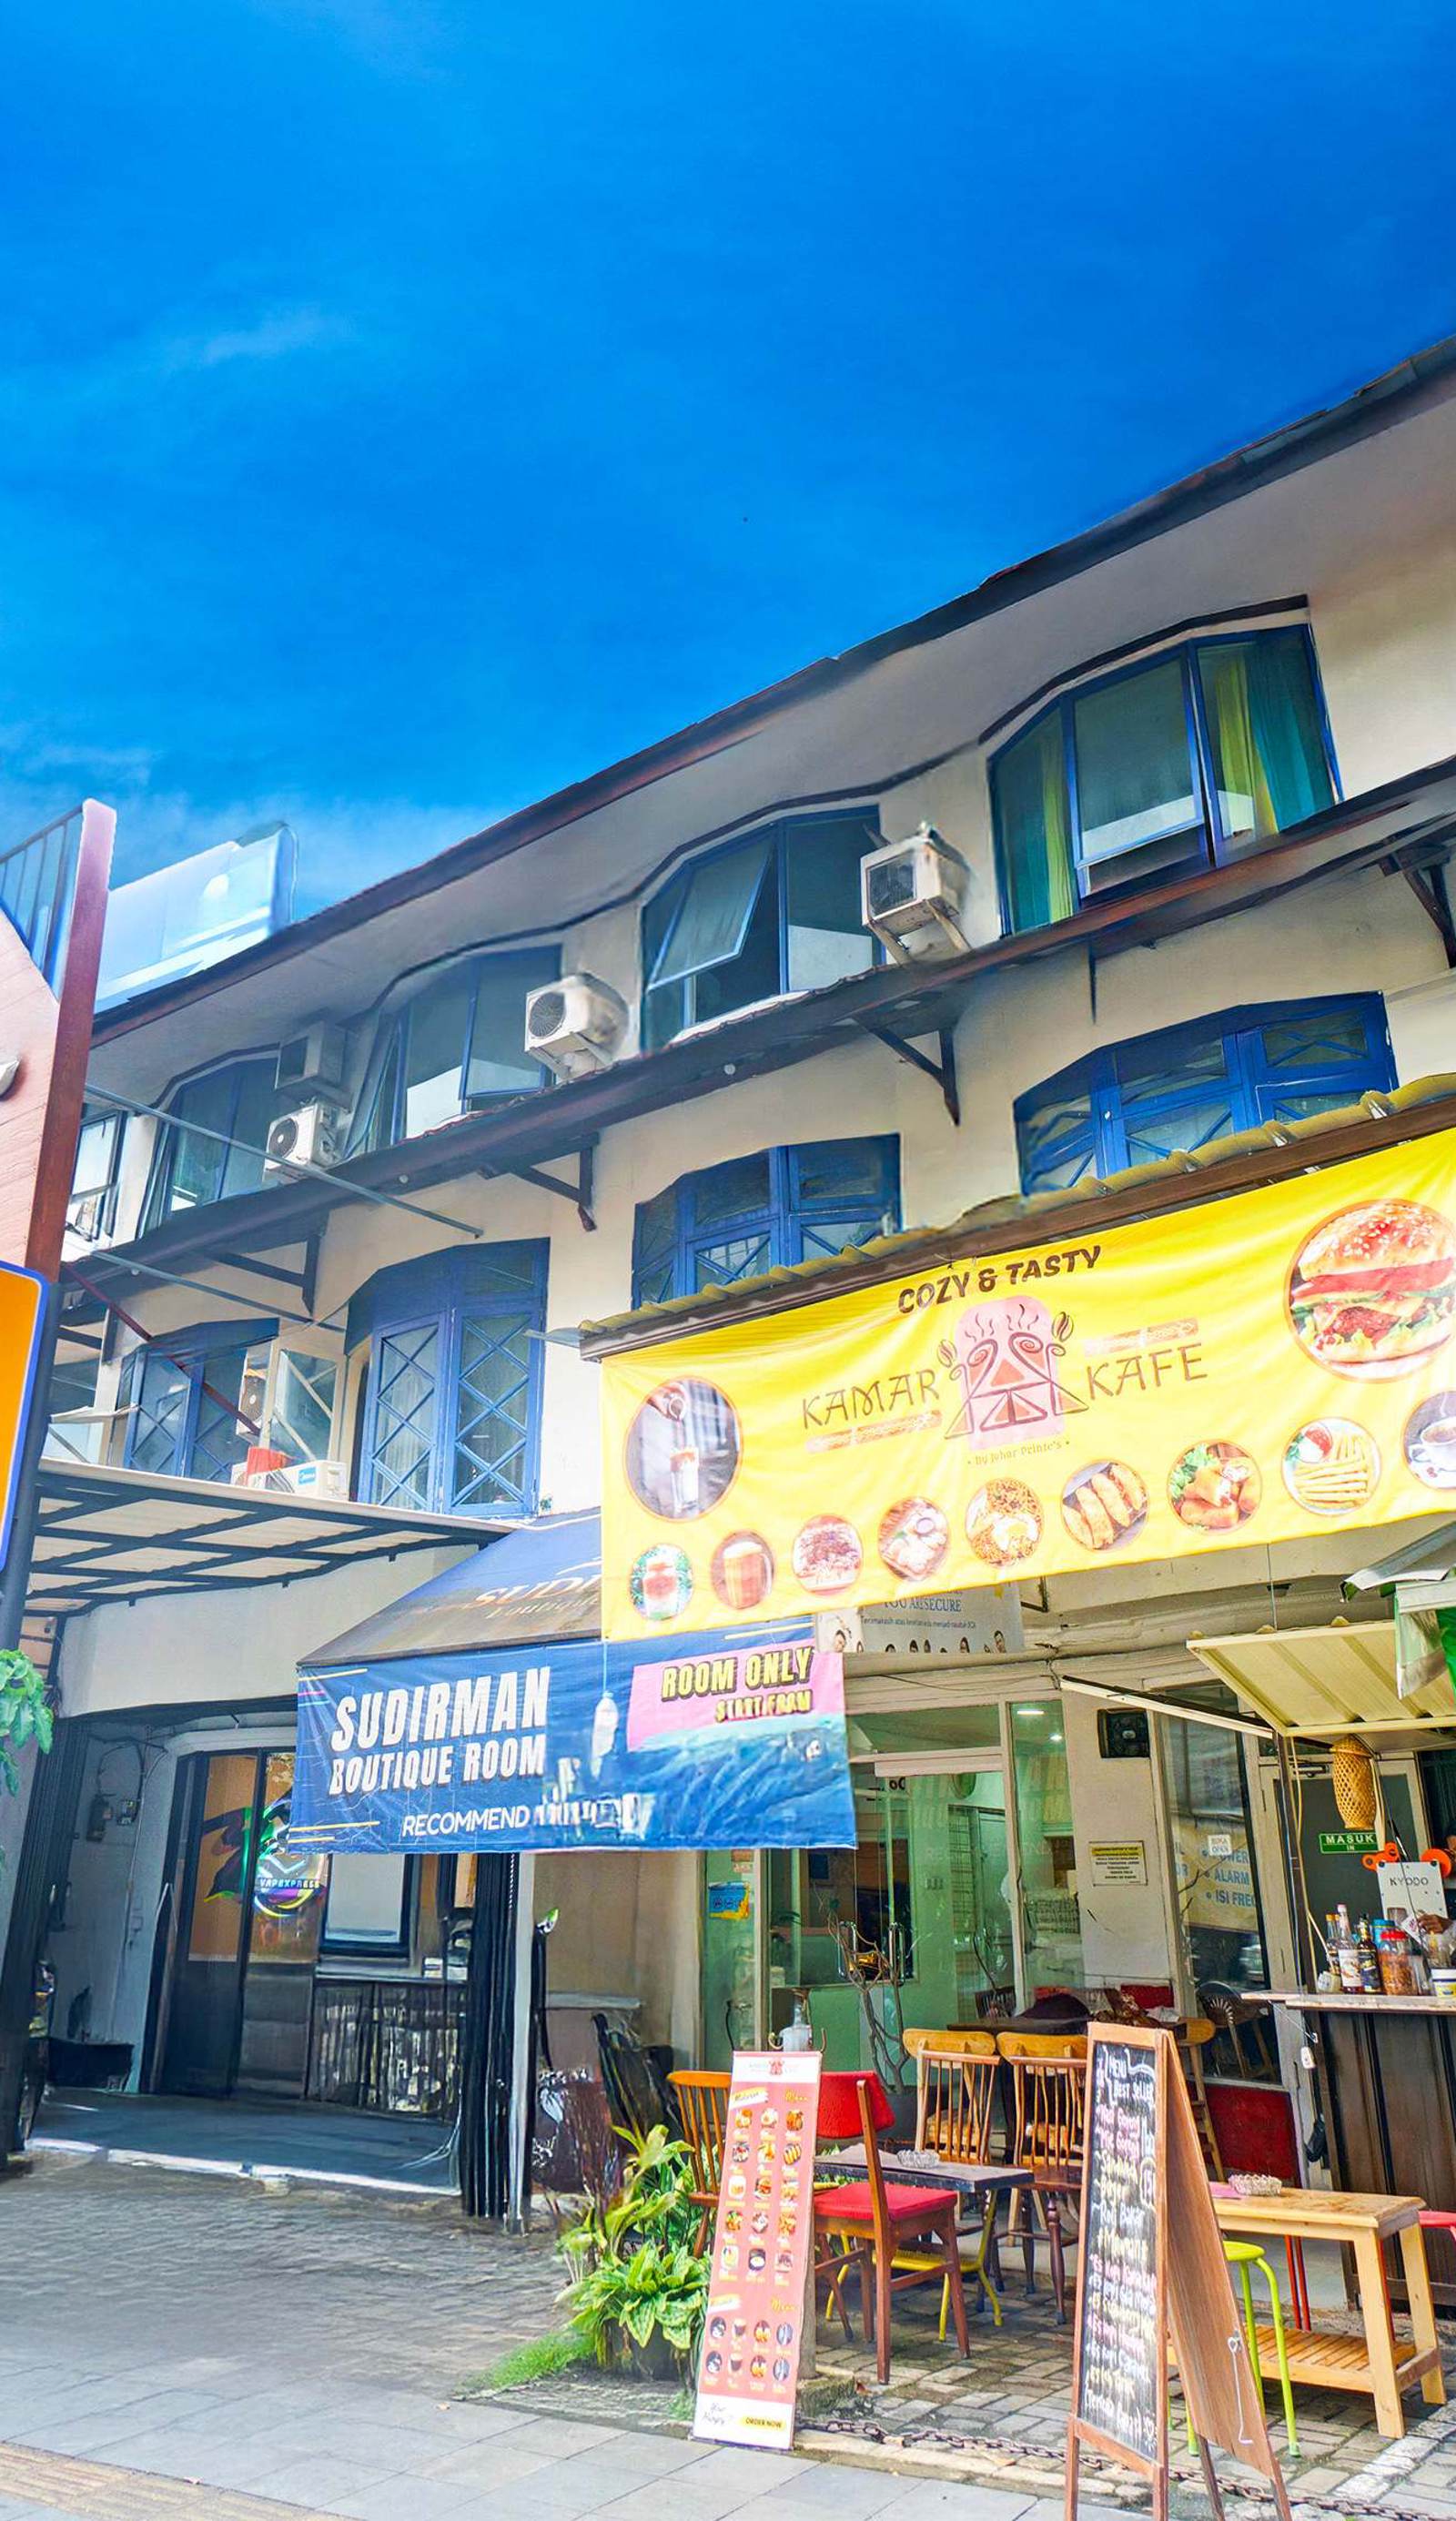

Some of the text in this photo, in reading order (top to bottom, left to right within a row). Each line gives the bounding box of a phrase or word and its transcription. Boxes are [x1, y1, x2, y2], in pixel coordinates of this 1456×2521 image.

[898, 1245, 1101, 1314] COZY & TASTY
[803, 1368, 941, 1430] KAMAR
[1086, 1342, 1208, 1401] KAFE
[921, 1597, 962, 1612] SECURE
[662, 1645, 814, 1702] ROOM ONLY
[331, 1666, 551, 1752] SUDIRMAN
[329, 1734, 546, 1796] BOUTIQUE ROOM
[1325, 1834, 1375, 1844] MASUK
[1215, 1868, 1249, 1885] ALARM
[1215, 1889, 1228, 1905] ISI
[745, 2417, 783, 2428] ORDER NOW
